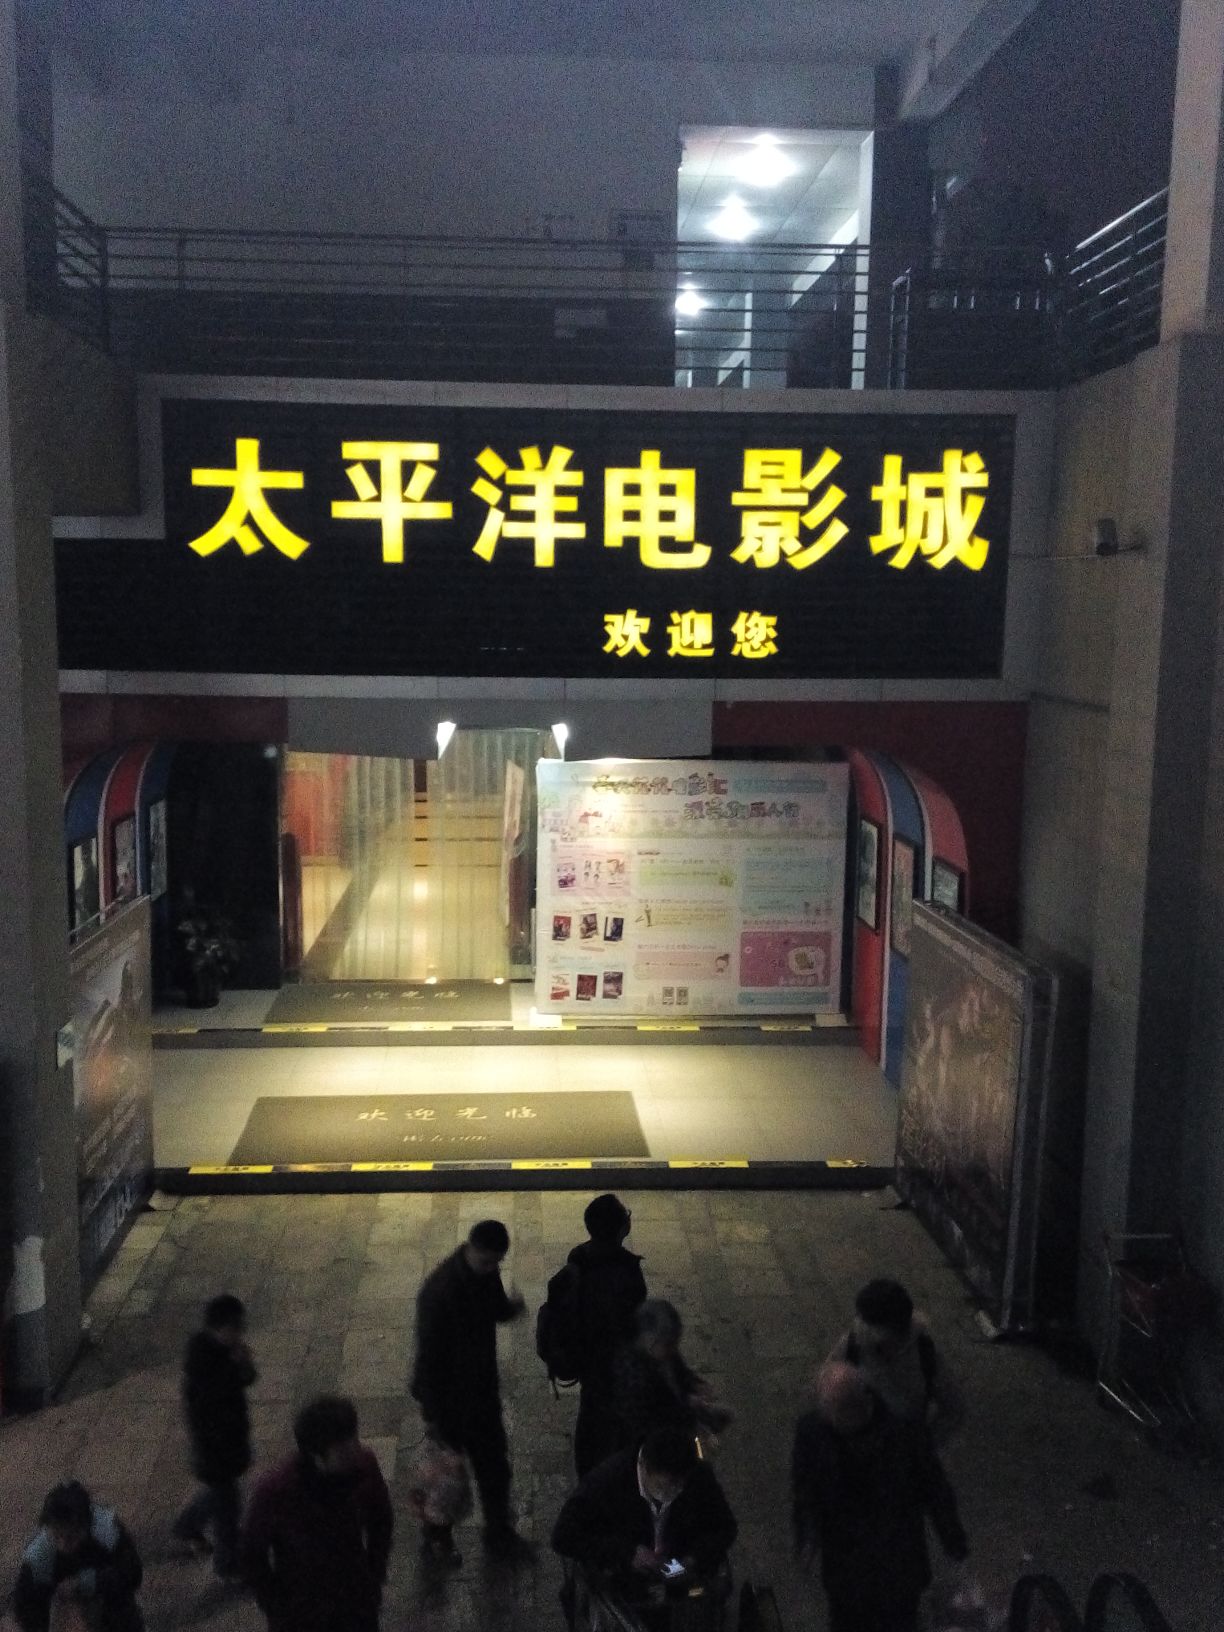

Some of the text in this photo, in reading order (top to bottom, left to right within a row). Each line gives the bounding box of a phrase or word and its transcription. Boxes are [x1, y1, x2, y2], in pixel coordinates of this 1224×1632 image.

[188, 437, 991, 572] 太平洋电影城
[602, 608, 779, 660] 欢迎您
